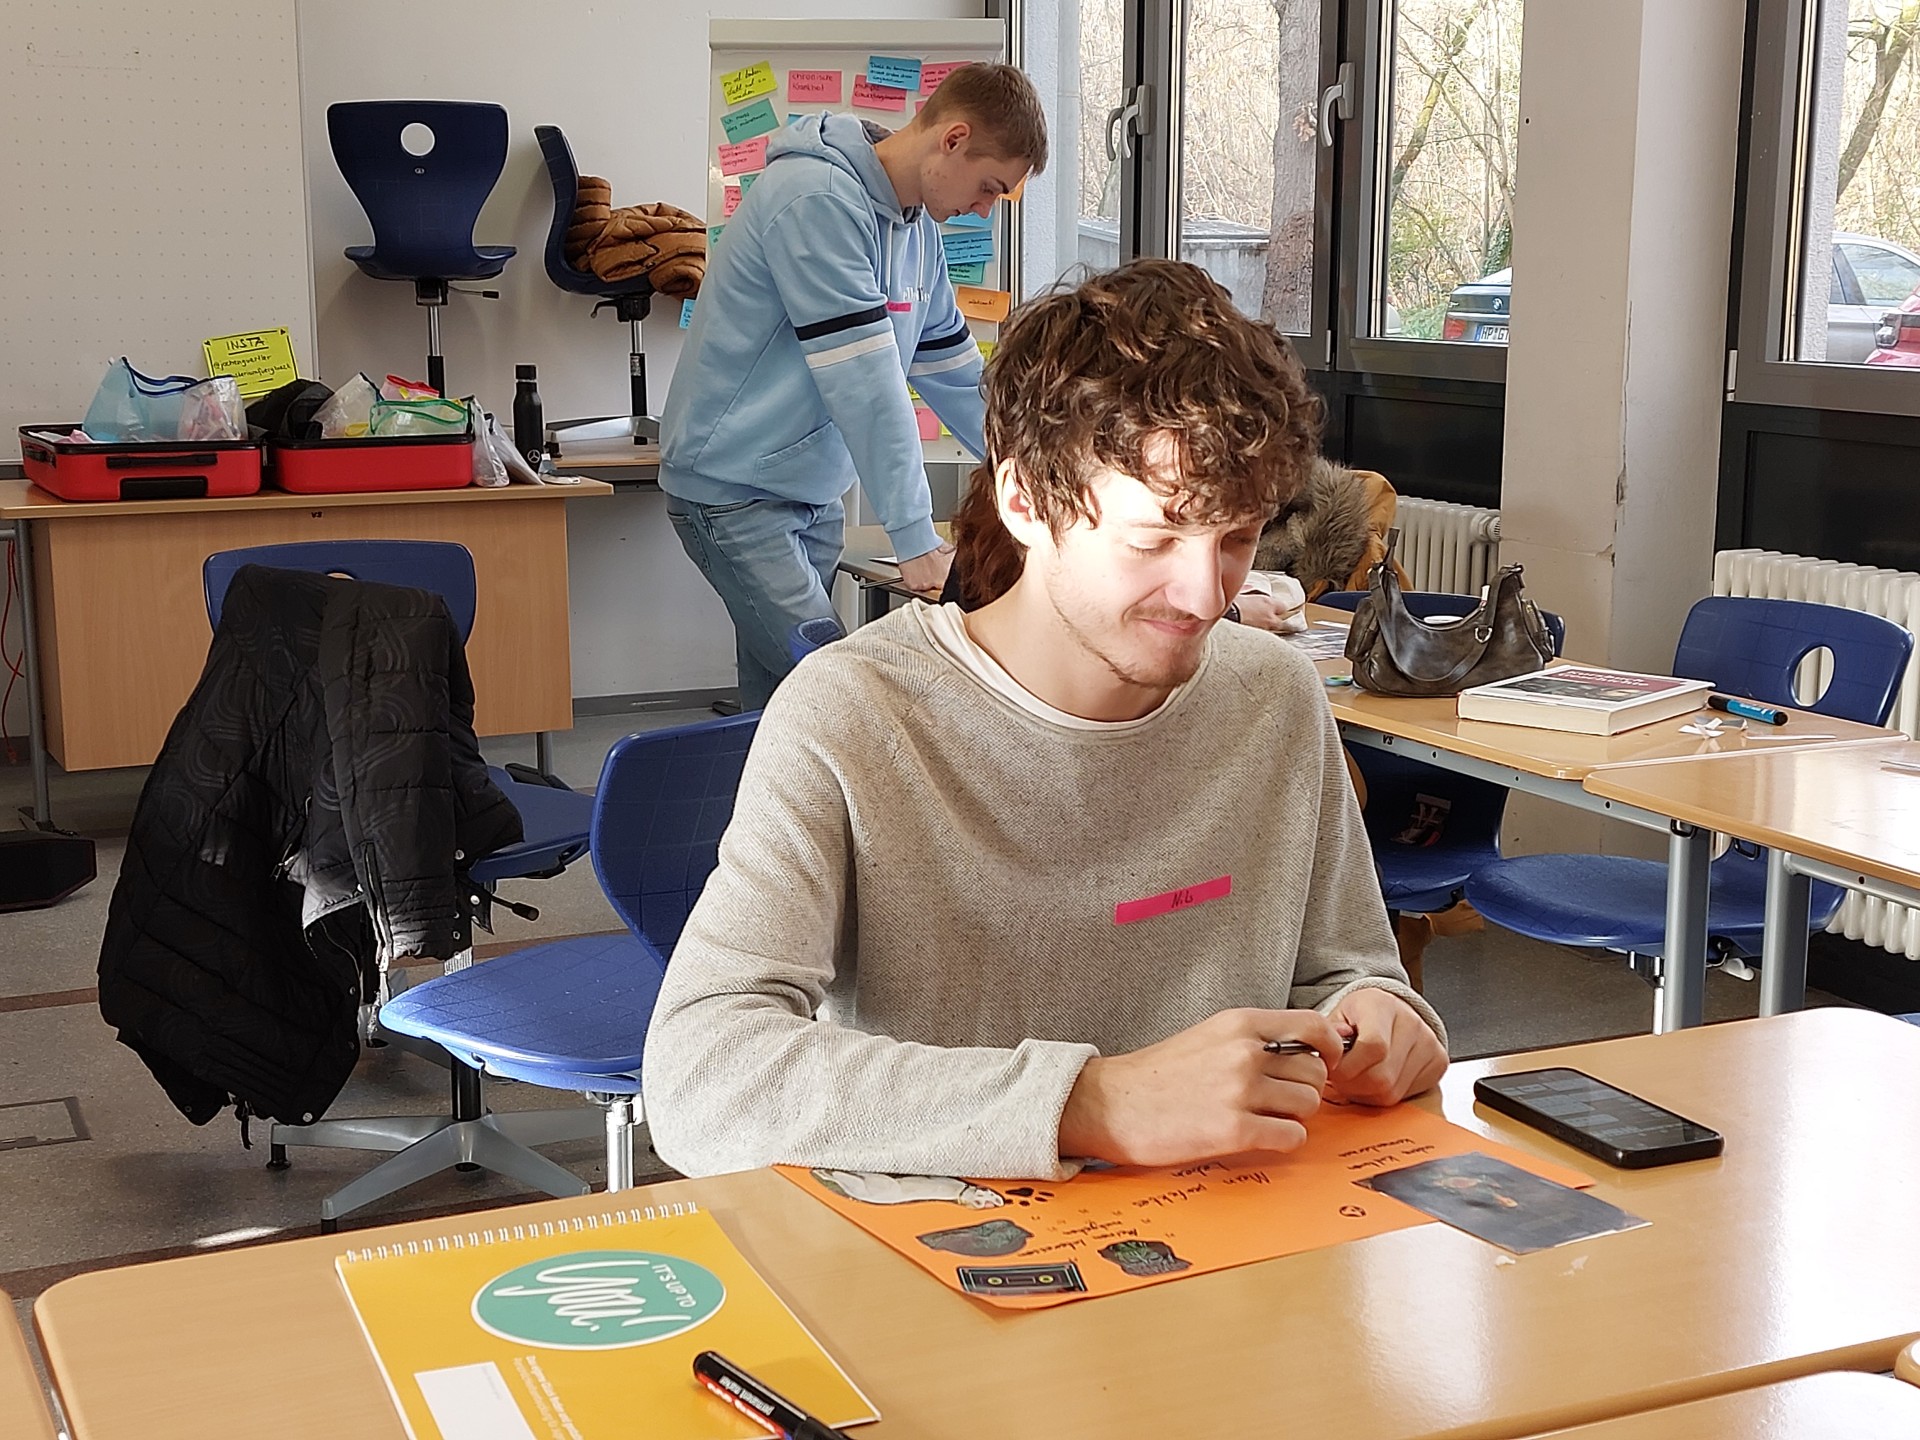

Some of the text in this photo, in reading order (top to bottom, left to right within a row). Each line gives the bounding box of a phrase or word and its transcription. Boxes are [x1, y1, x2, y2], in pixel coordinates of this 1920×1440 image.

[226, 337, 265, 350] INSTA
[652, 1263, 697, 1308] IT'S UP TO
